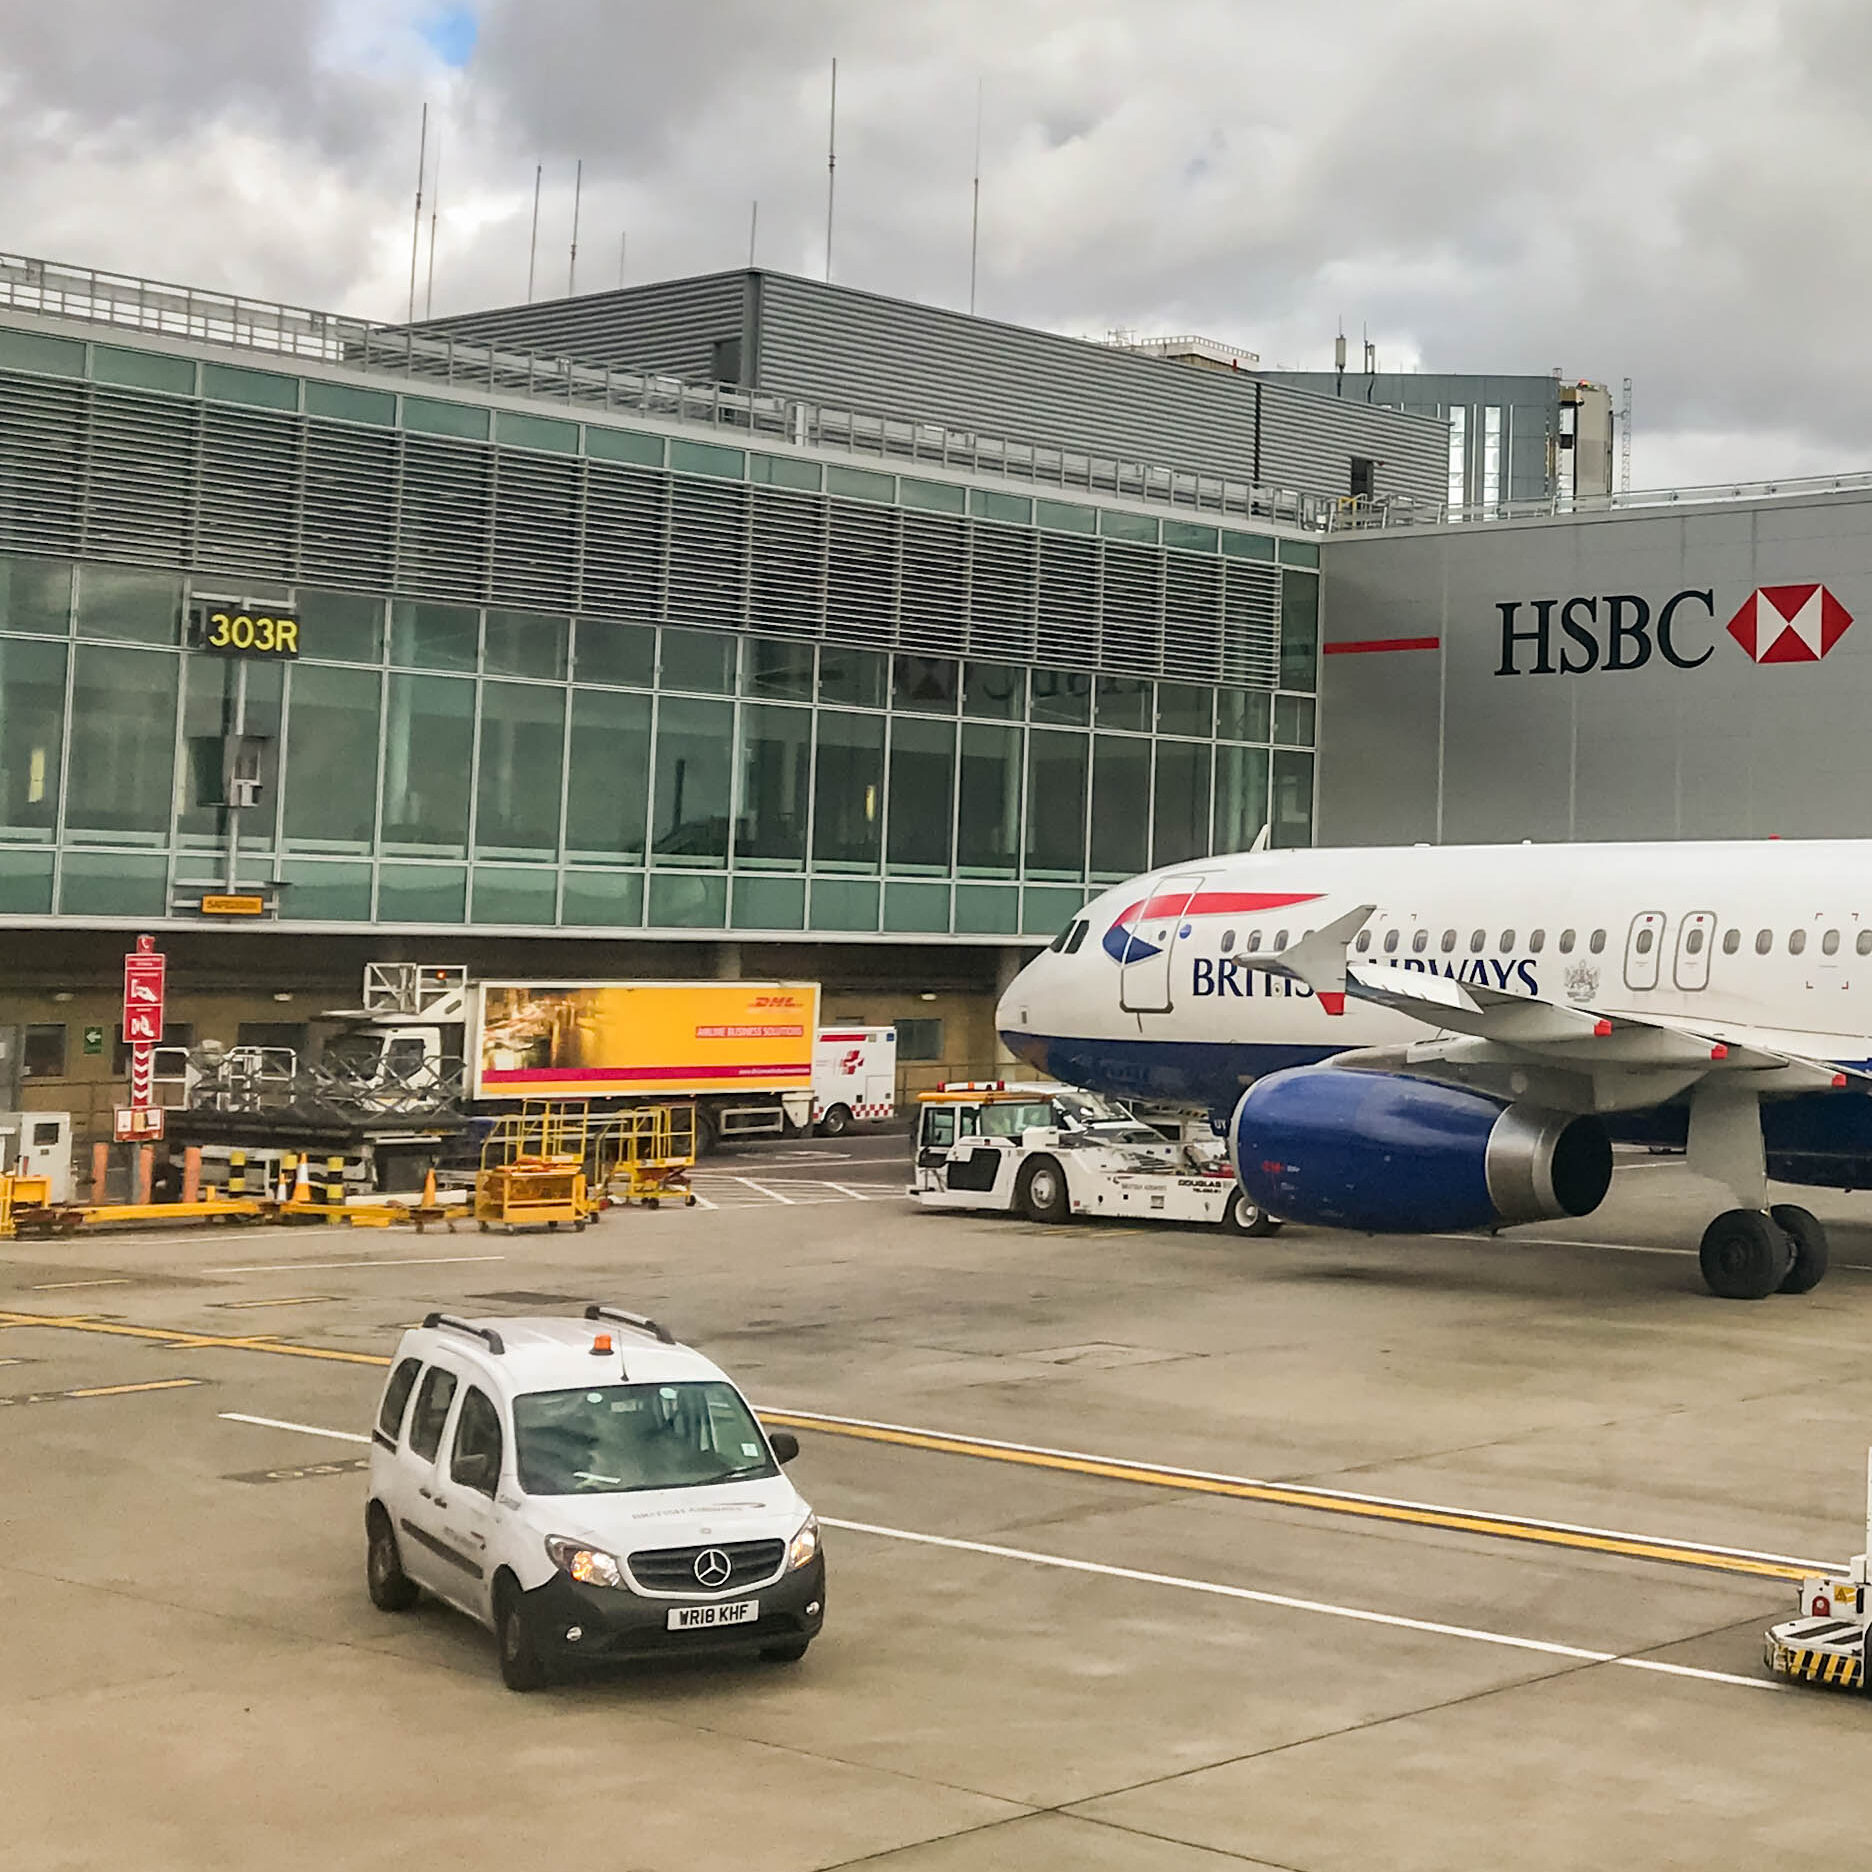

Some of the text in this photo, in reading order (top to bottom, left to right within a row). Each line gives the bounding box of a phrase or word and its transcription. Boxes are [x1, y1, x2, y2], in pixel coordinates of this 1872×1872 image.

[208, 613, 298, 653] 303R
[1494, 588, 1716, 676] HSBC
[1192, 957, 1538, 998] BRII WAYS
[751, 996, 798, 1008] DHL
[1178, 1179, 1222, 1189] DOUGLAS
[679, 1604, 749, 1626] WR18 KHF
